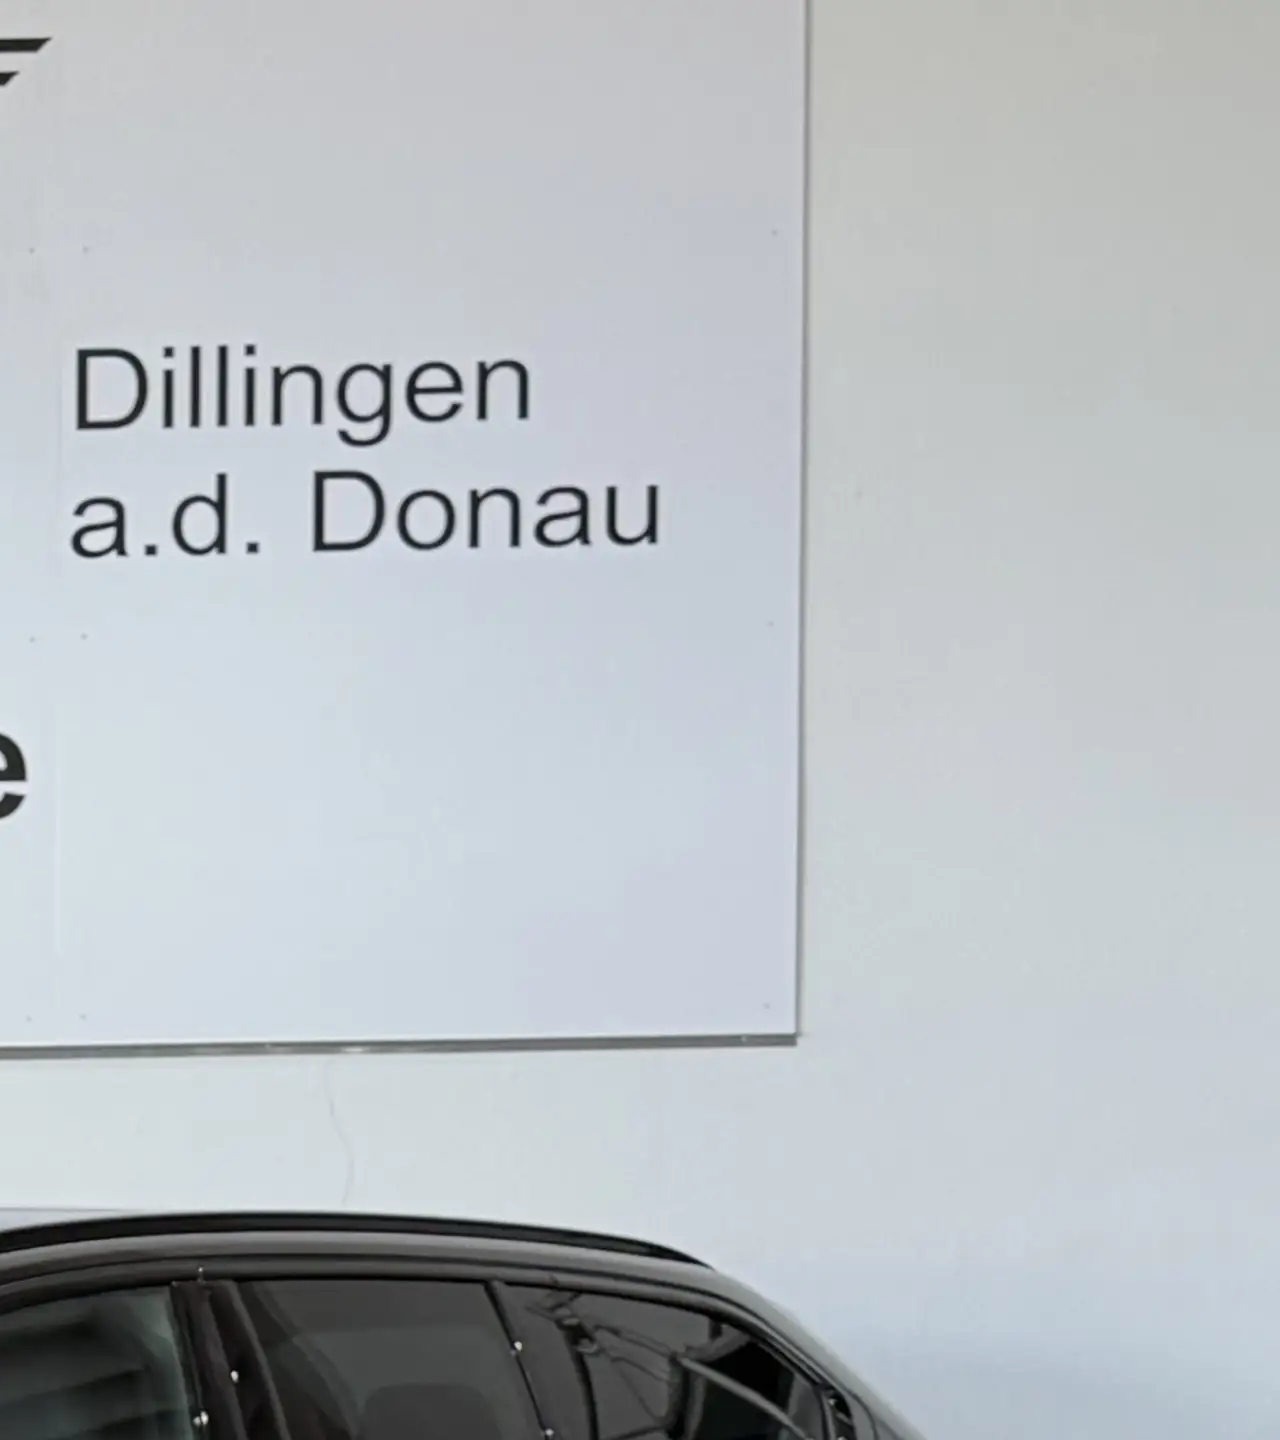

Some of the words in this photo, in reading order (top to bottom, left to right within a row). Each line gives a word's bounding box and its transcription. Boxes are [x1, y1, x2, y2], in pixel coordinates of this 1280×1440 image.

[75, 344, 530, 448] Dillingen
[71, 472, 260, 560] a.d.
[312, 470, 659, 553] Donau
